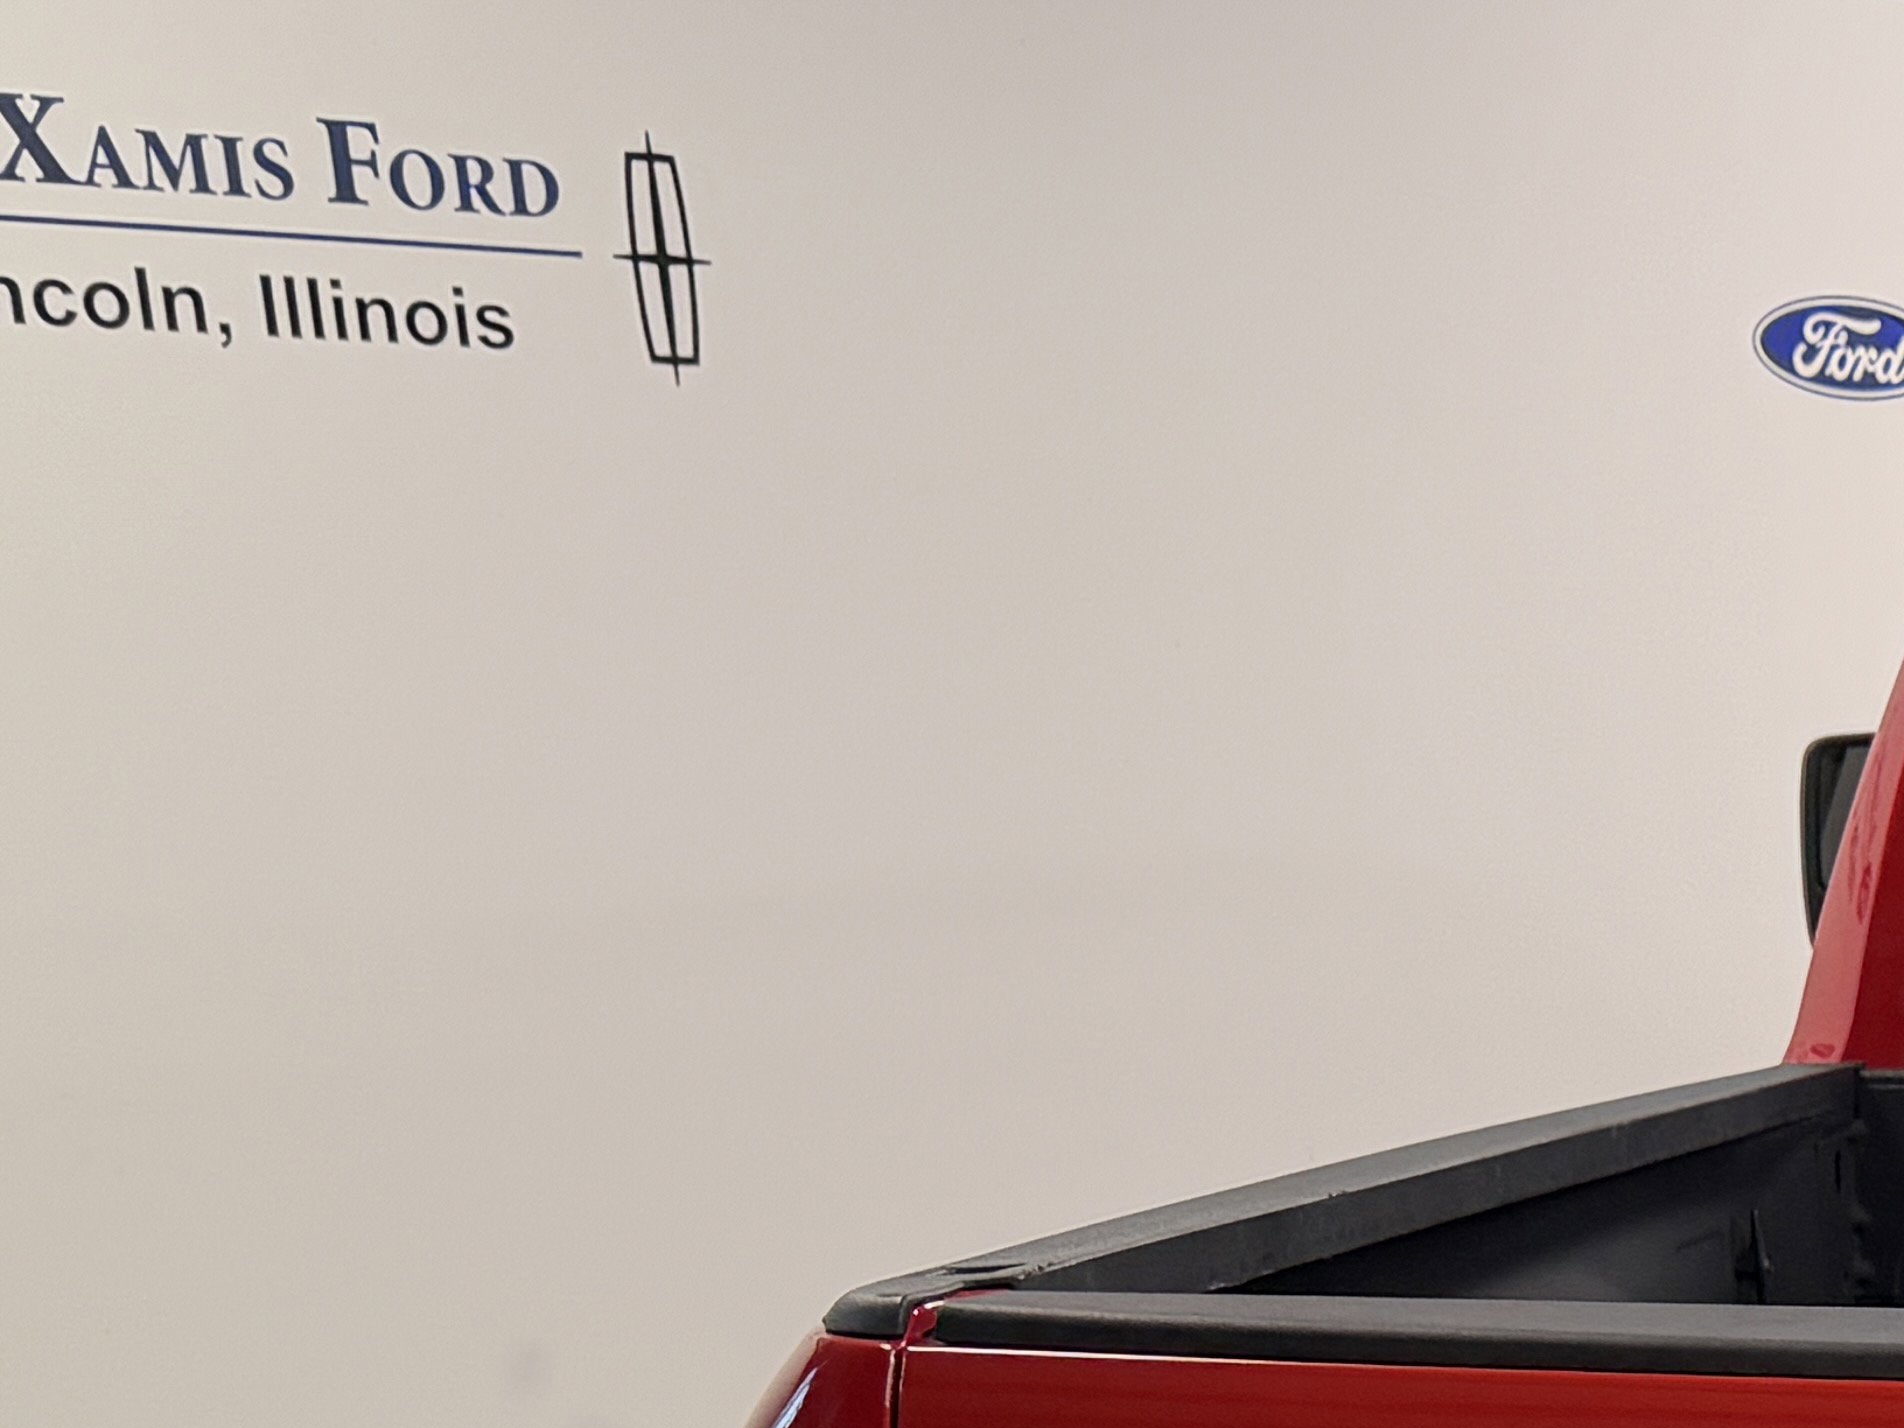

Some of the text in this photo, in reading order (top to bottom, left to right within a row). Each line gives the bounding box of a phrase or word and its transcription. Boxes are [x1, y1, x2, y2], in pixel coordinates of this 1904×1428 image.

[0, 93, 561, 217] XAMIS FORD
[260, 274, 516, 350] Illinois
